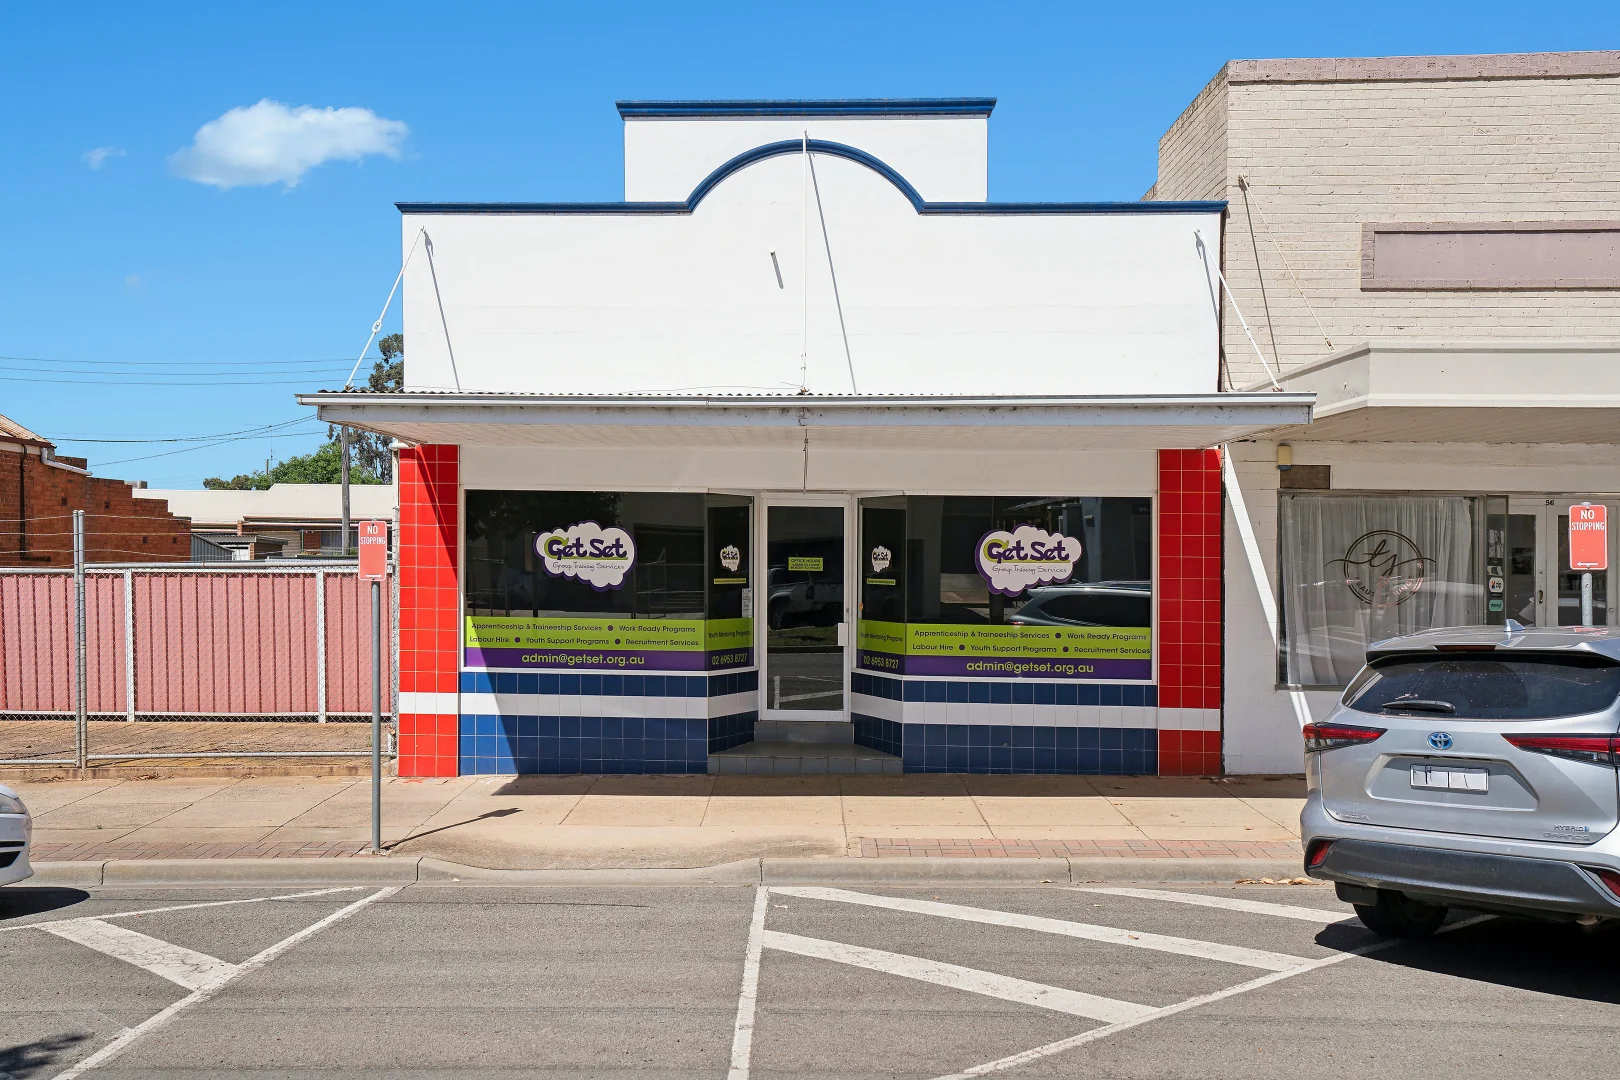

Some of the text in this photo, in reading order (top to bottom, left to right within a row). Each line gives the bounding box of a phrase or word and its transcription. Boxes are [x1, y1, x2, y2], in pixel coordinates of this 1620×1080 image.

[1580, 510, 1594, 520] NO
[367, 526, 378, 534] NO
[1572, 522, 1604, 530] STOPPING
[547, 536, 628, 560] Get Set
[987, 540, 1070, 564] Get Set
[552, 562, 572, 571] Group
[573, 562, 594, 571] Training
[992, 565, 1012, 574] Group
[1013, 565, 1036, 575] Training
[522, 653, 645, 666] admin@getset.org.au
[712, 653, 748, 665] 02 6953 8727
[864, 656, 898, 668] 02 6953 8727
[966, 661, 1094, 674] admin@getset.org.au
